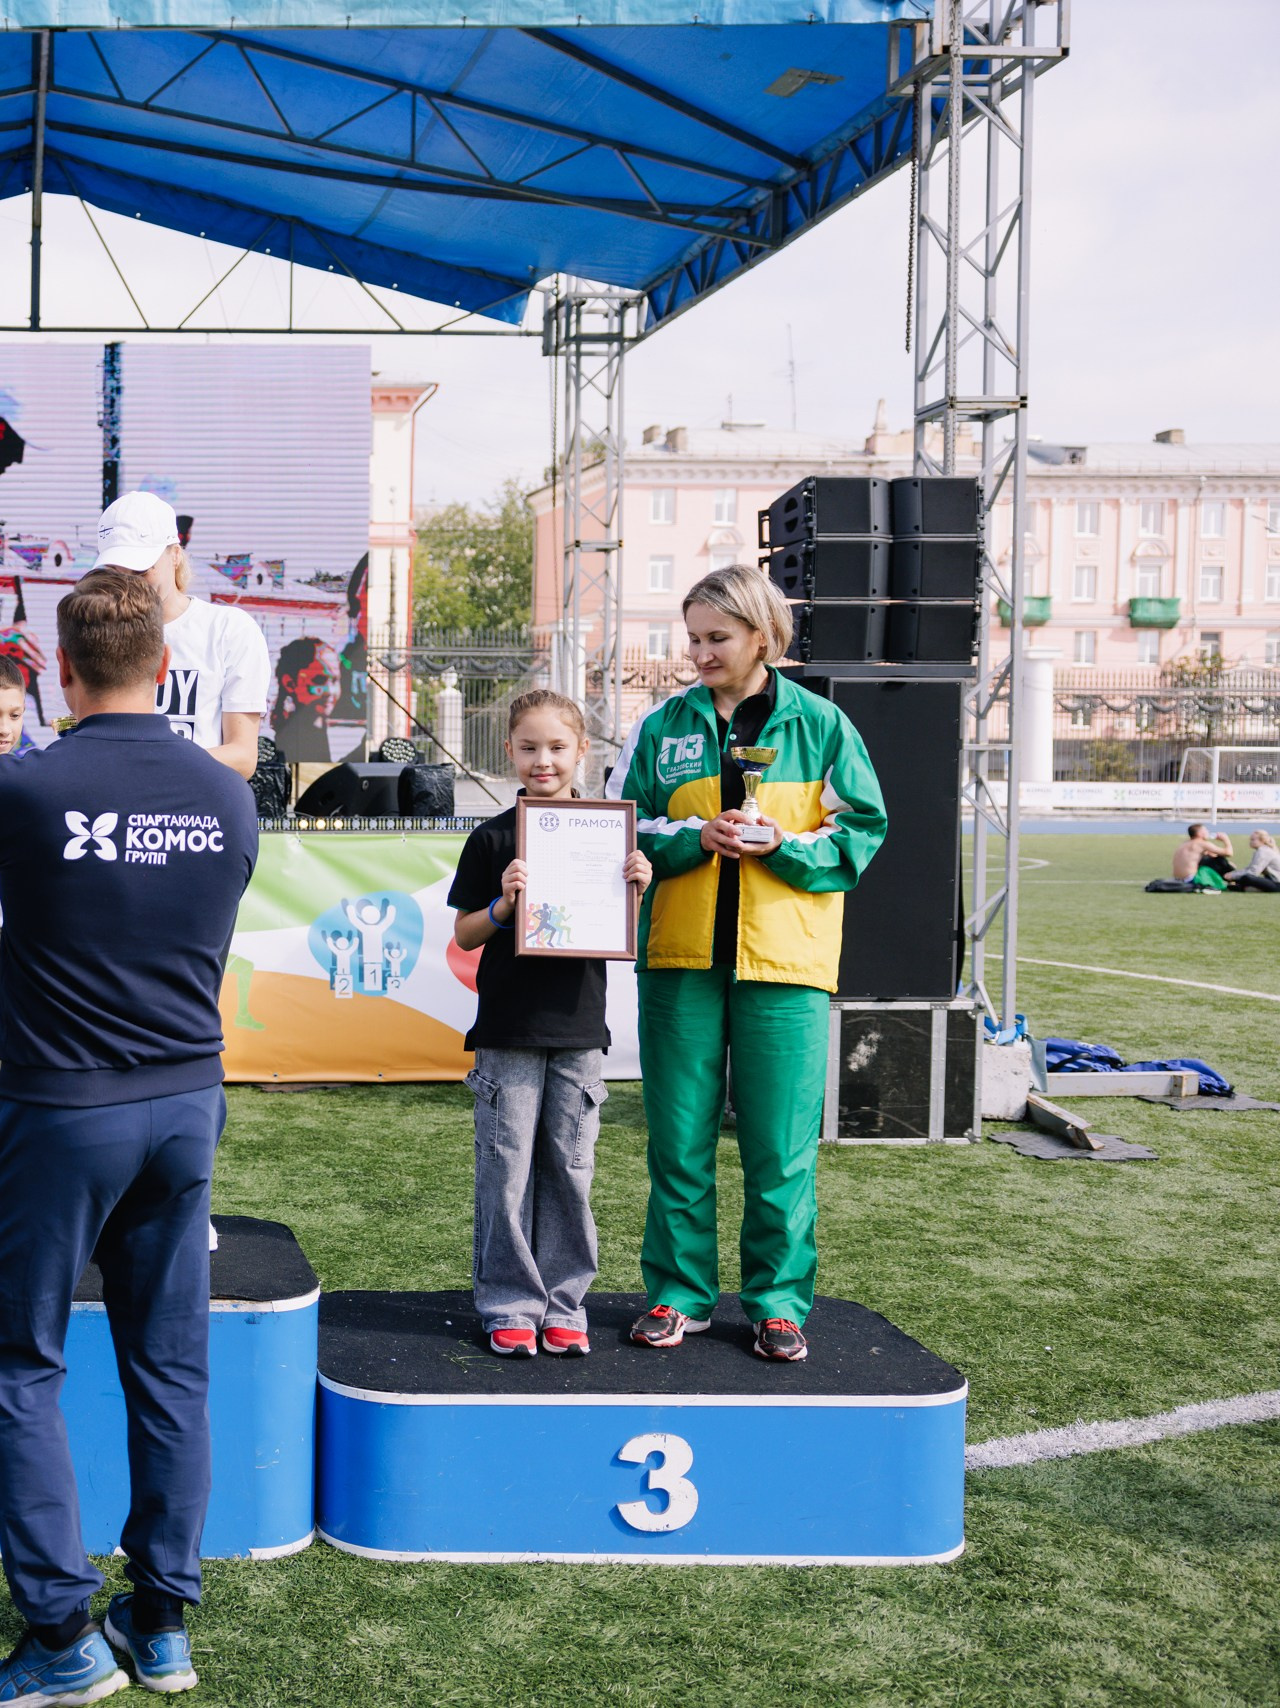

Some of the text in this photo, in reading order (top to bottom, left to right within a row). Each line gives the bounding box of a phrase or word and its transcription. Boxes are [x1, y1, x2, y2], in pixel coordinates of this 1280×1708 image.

[128, 814, 220, 830] СПАРТАКИАДА
[568, 818, 624, 829] ГРАМОТА
[125, 827, 224, 853] КОМОС
[124, 850, 168, 865] ГРУПП
[338, 977, 350, 995] 2
[616, 1432, 700, 1532] 3
